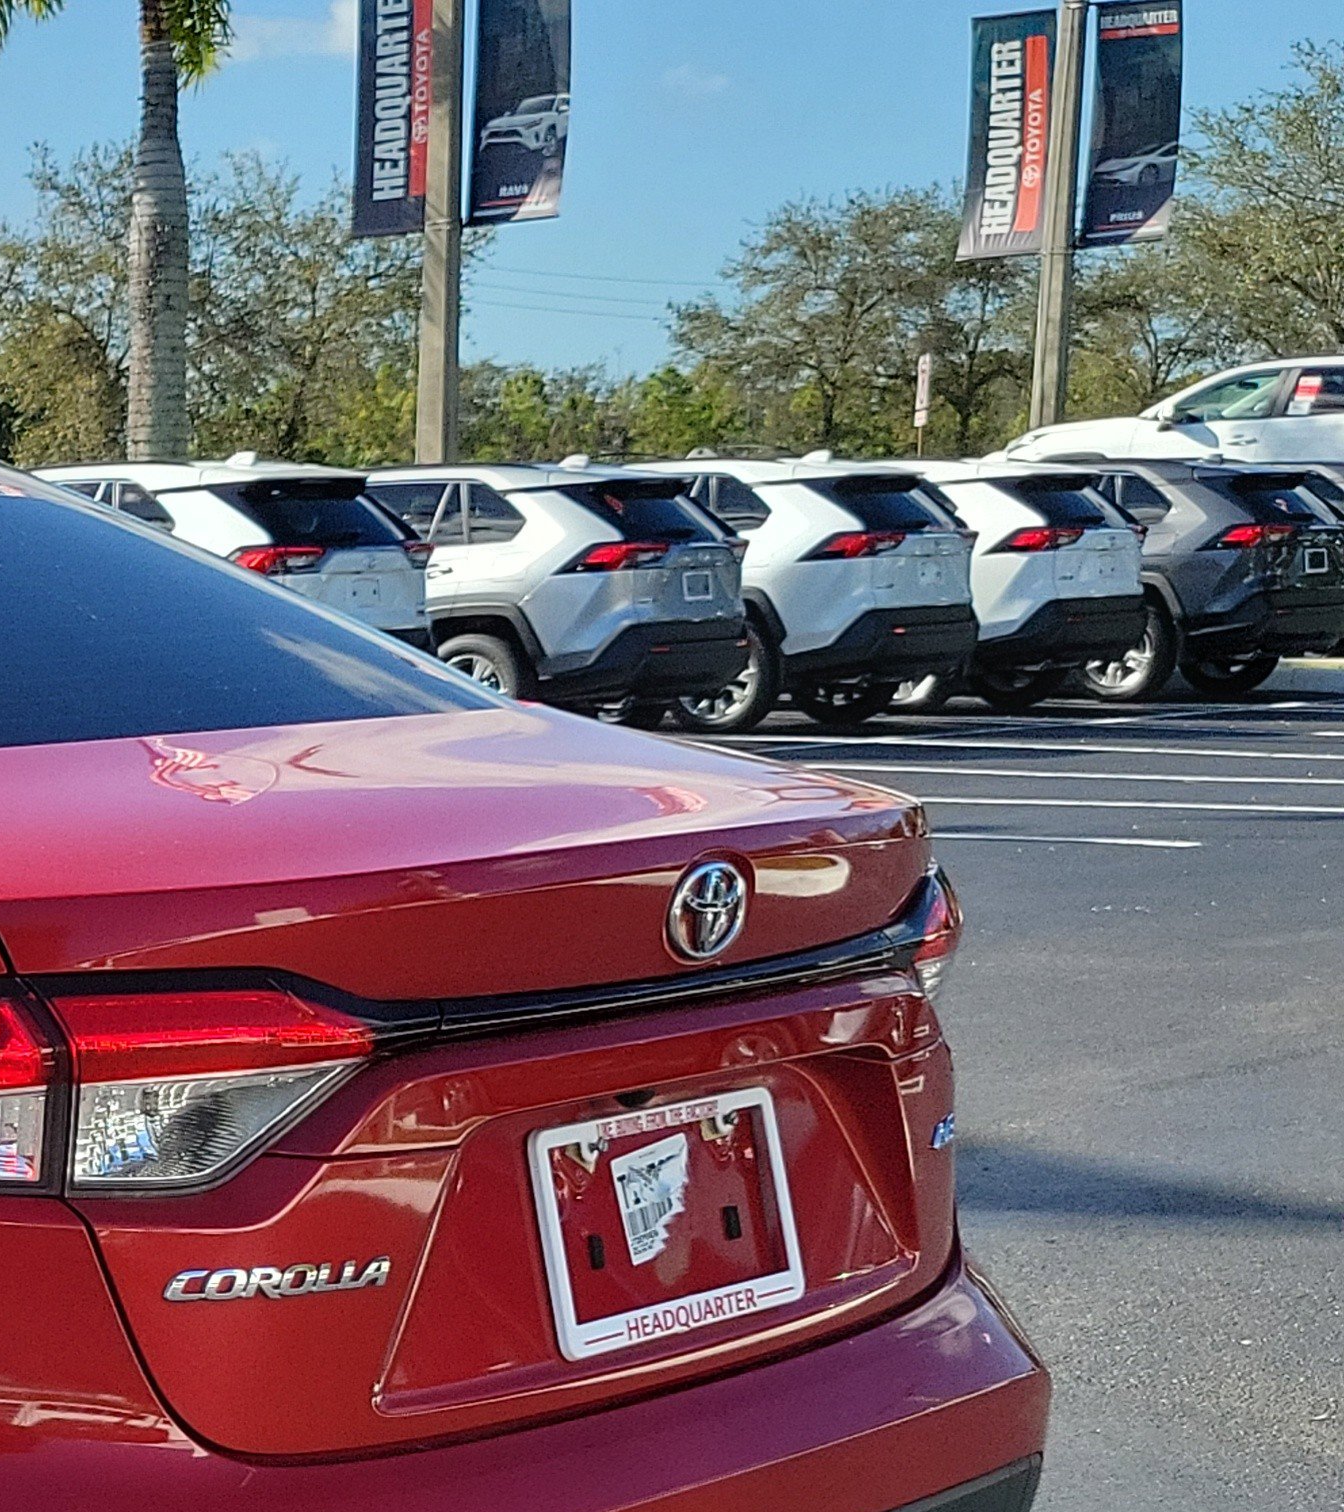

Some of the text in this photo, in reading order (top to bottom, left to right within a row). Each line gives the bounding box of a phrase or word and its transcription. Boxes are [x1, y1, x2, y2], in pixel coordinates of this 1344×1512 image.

[414, 28, 431, 113] TOYOTA
[980, 39, 1022, 236] HEADQUARTER
[1025, 88, 1043, 164] TOYOTA
[163, 1255, 392, 1301] COROLLA
[625, 1287, 758, 1341] HEADQUARTER
